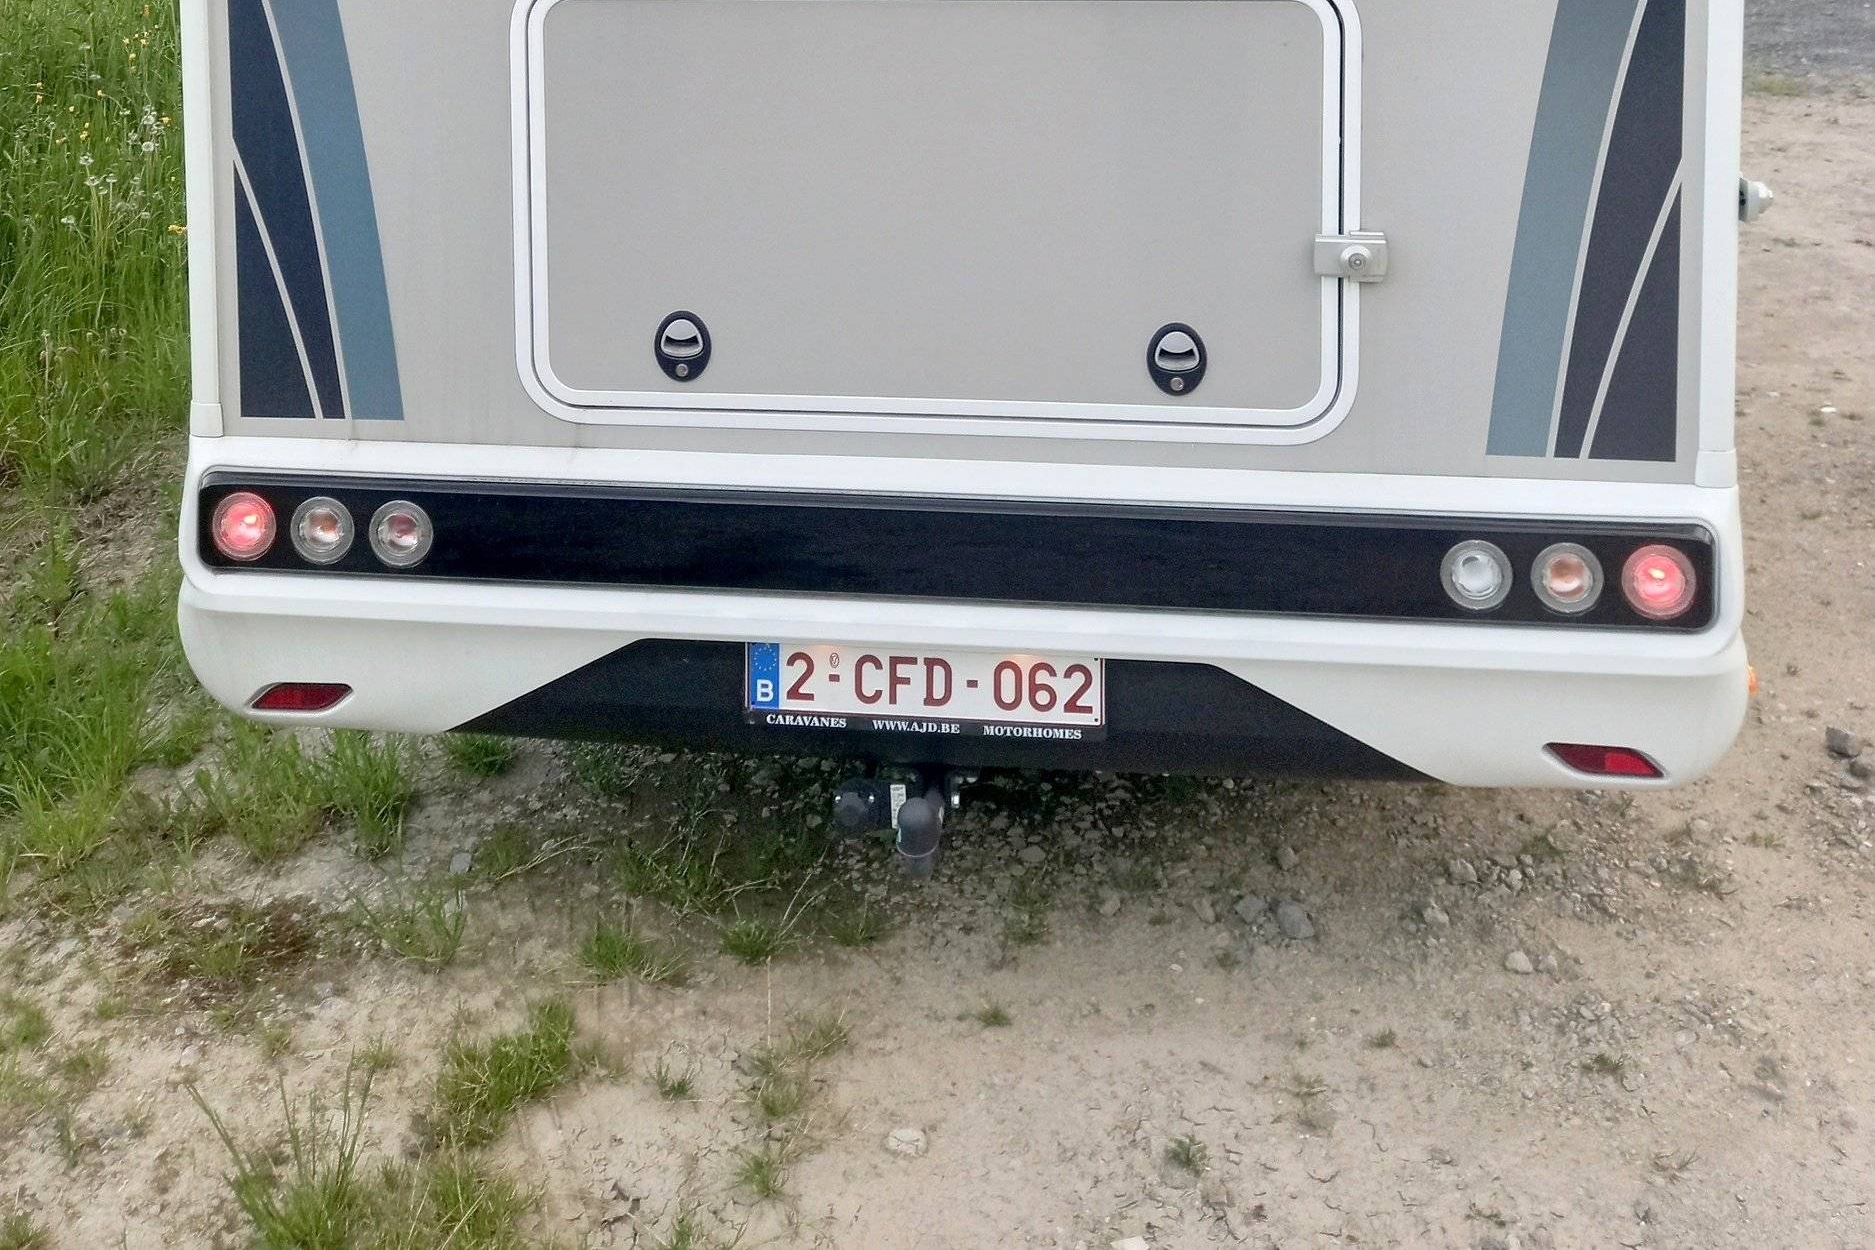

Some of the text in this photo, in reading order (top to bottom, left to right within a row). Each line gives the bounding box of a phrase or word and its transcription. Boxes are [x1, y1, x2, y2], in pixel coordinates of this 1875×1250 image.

[756, 679, 774, 702] B
[766, 714, 1082, 740] CARAVANES WWW.AJD.BE MOTORHOMES
